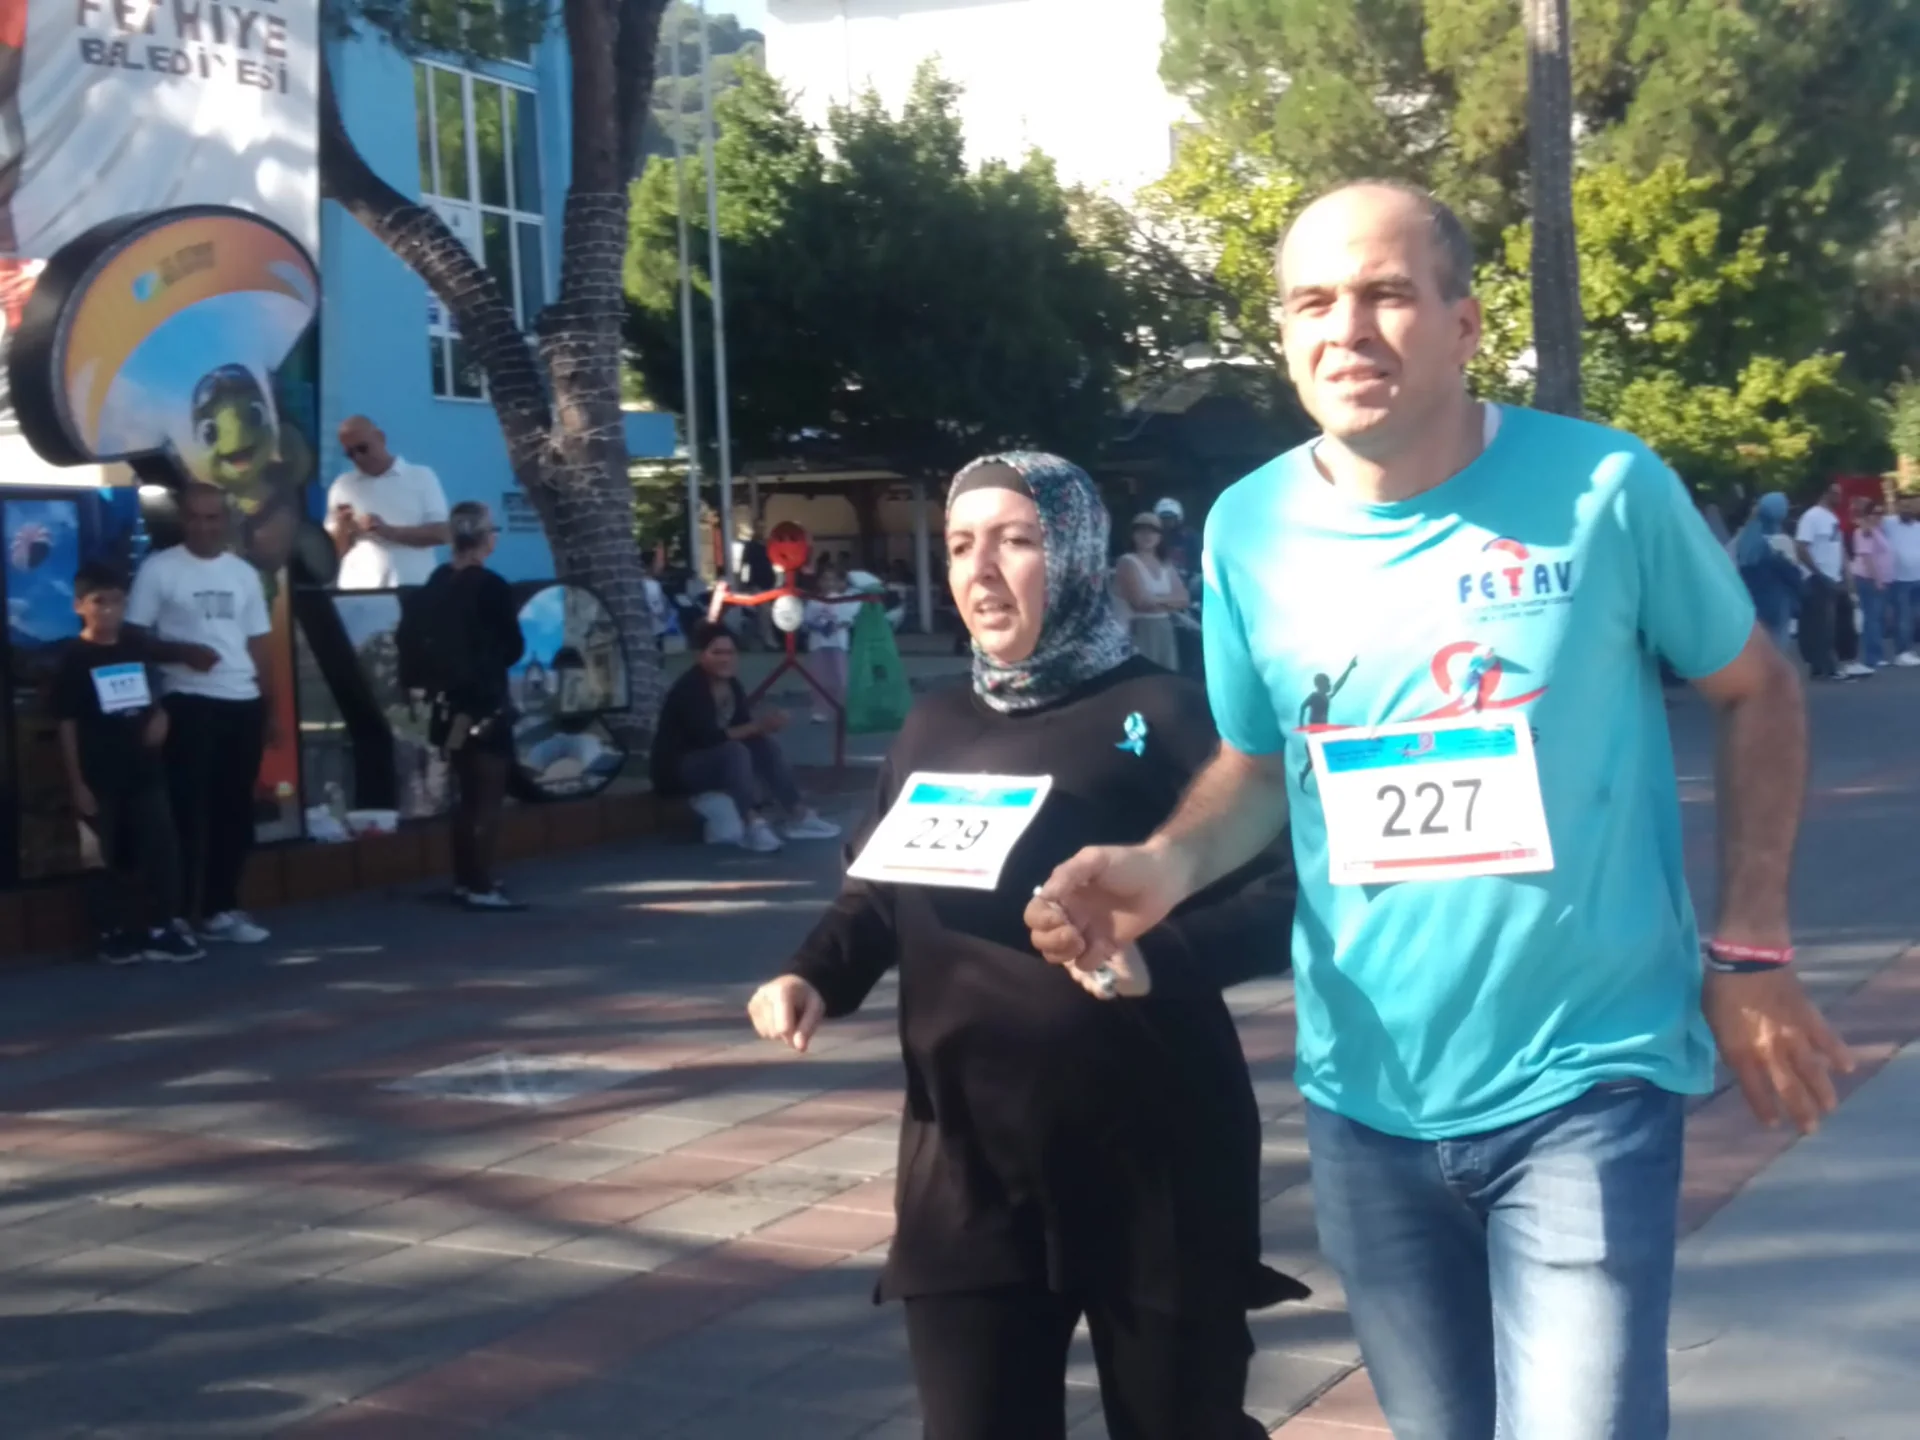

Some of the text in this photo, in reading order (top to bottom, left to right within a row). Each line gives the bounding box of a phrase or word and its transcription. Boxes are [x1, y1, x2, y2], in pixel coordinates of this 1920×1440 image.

[1458, 560, 1574, 603] FETAV
[1376, 778, 1482, 838] 227
[904, 816, 990, 851] 229
